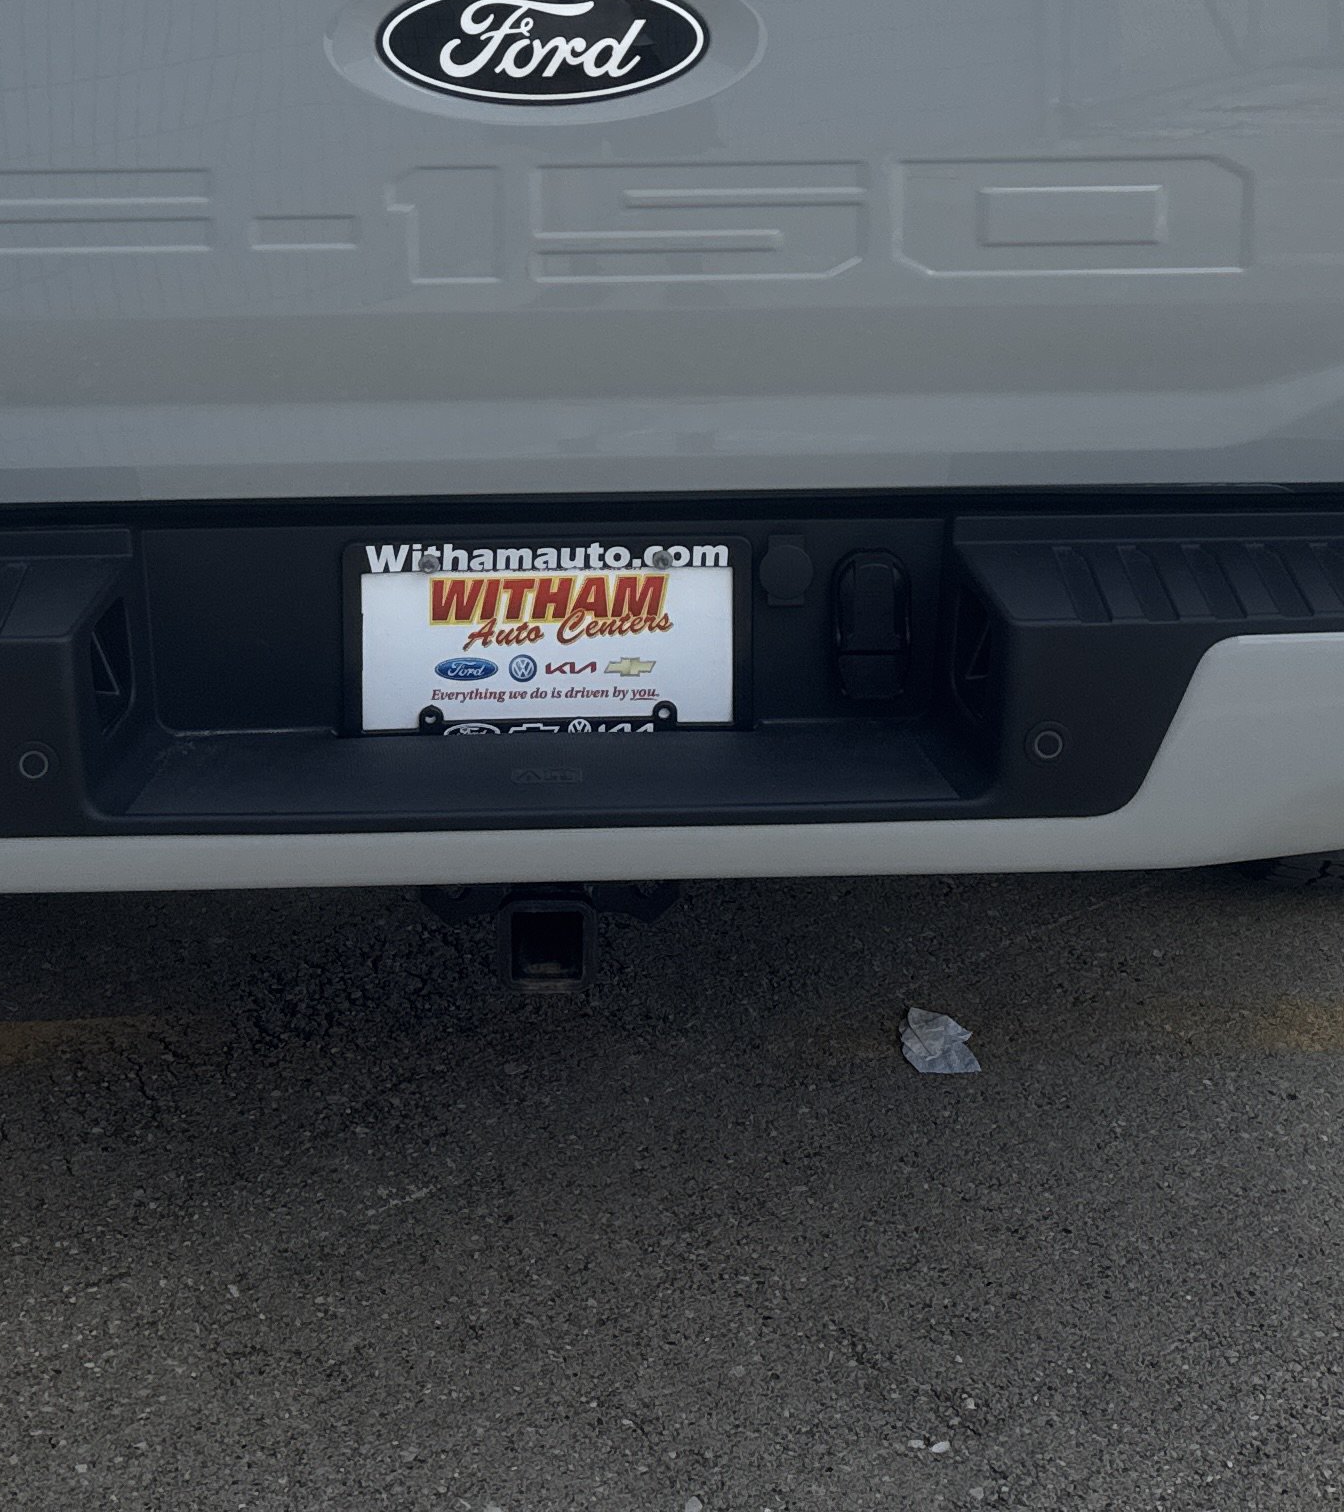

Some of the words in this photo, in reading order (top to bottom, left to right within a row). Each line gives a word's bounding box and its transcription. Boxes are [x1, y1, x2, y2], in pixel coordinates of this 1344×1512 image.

[429, 574, 669, 625] WITHAM
[462, 617, 544, 651] Auto
[555, 607, 674, 646] Centers
[545, 661, 597, 675] KIA
[431, 688, 506, 703] Everything
[508, 690, 528, 700] we
[530, 687, 548, 699] do
[551, 687, 561, 699] is
[565, 687, 609, 699] driven
[612, 686, 629, 701] by
[629, 688, 660, 701] you.
